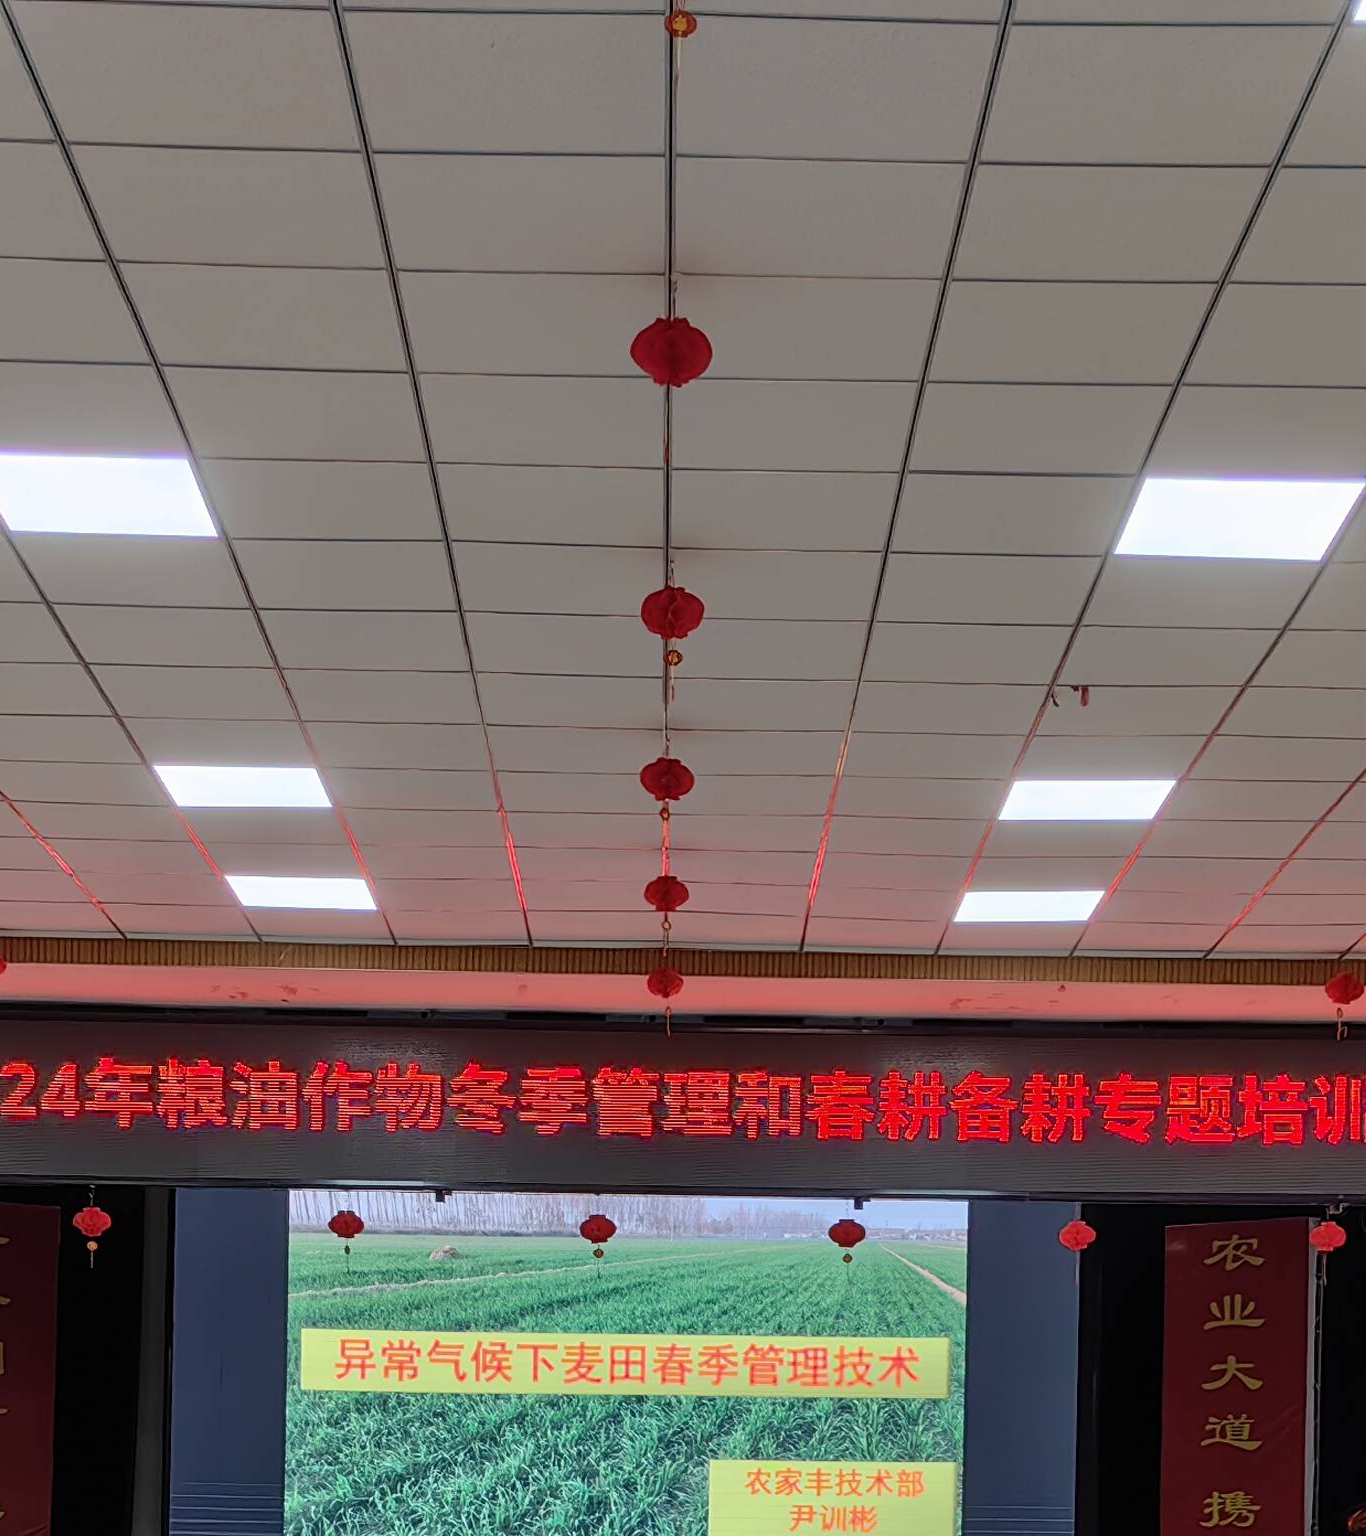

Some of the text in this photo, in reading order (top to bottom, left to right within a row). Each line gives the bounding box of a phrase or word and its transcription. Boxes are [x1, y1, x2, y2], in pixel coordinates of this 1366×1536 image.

[335, 1337, 921, 1388] 异常气候下麦田春季管理技术
[745, 1468, 925, 1498] 农家丰技术部
[789, 1504, 877, 1533] 尹训彬
